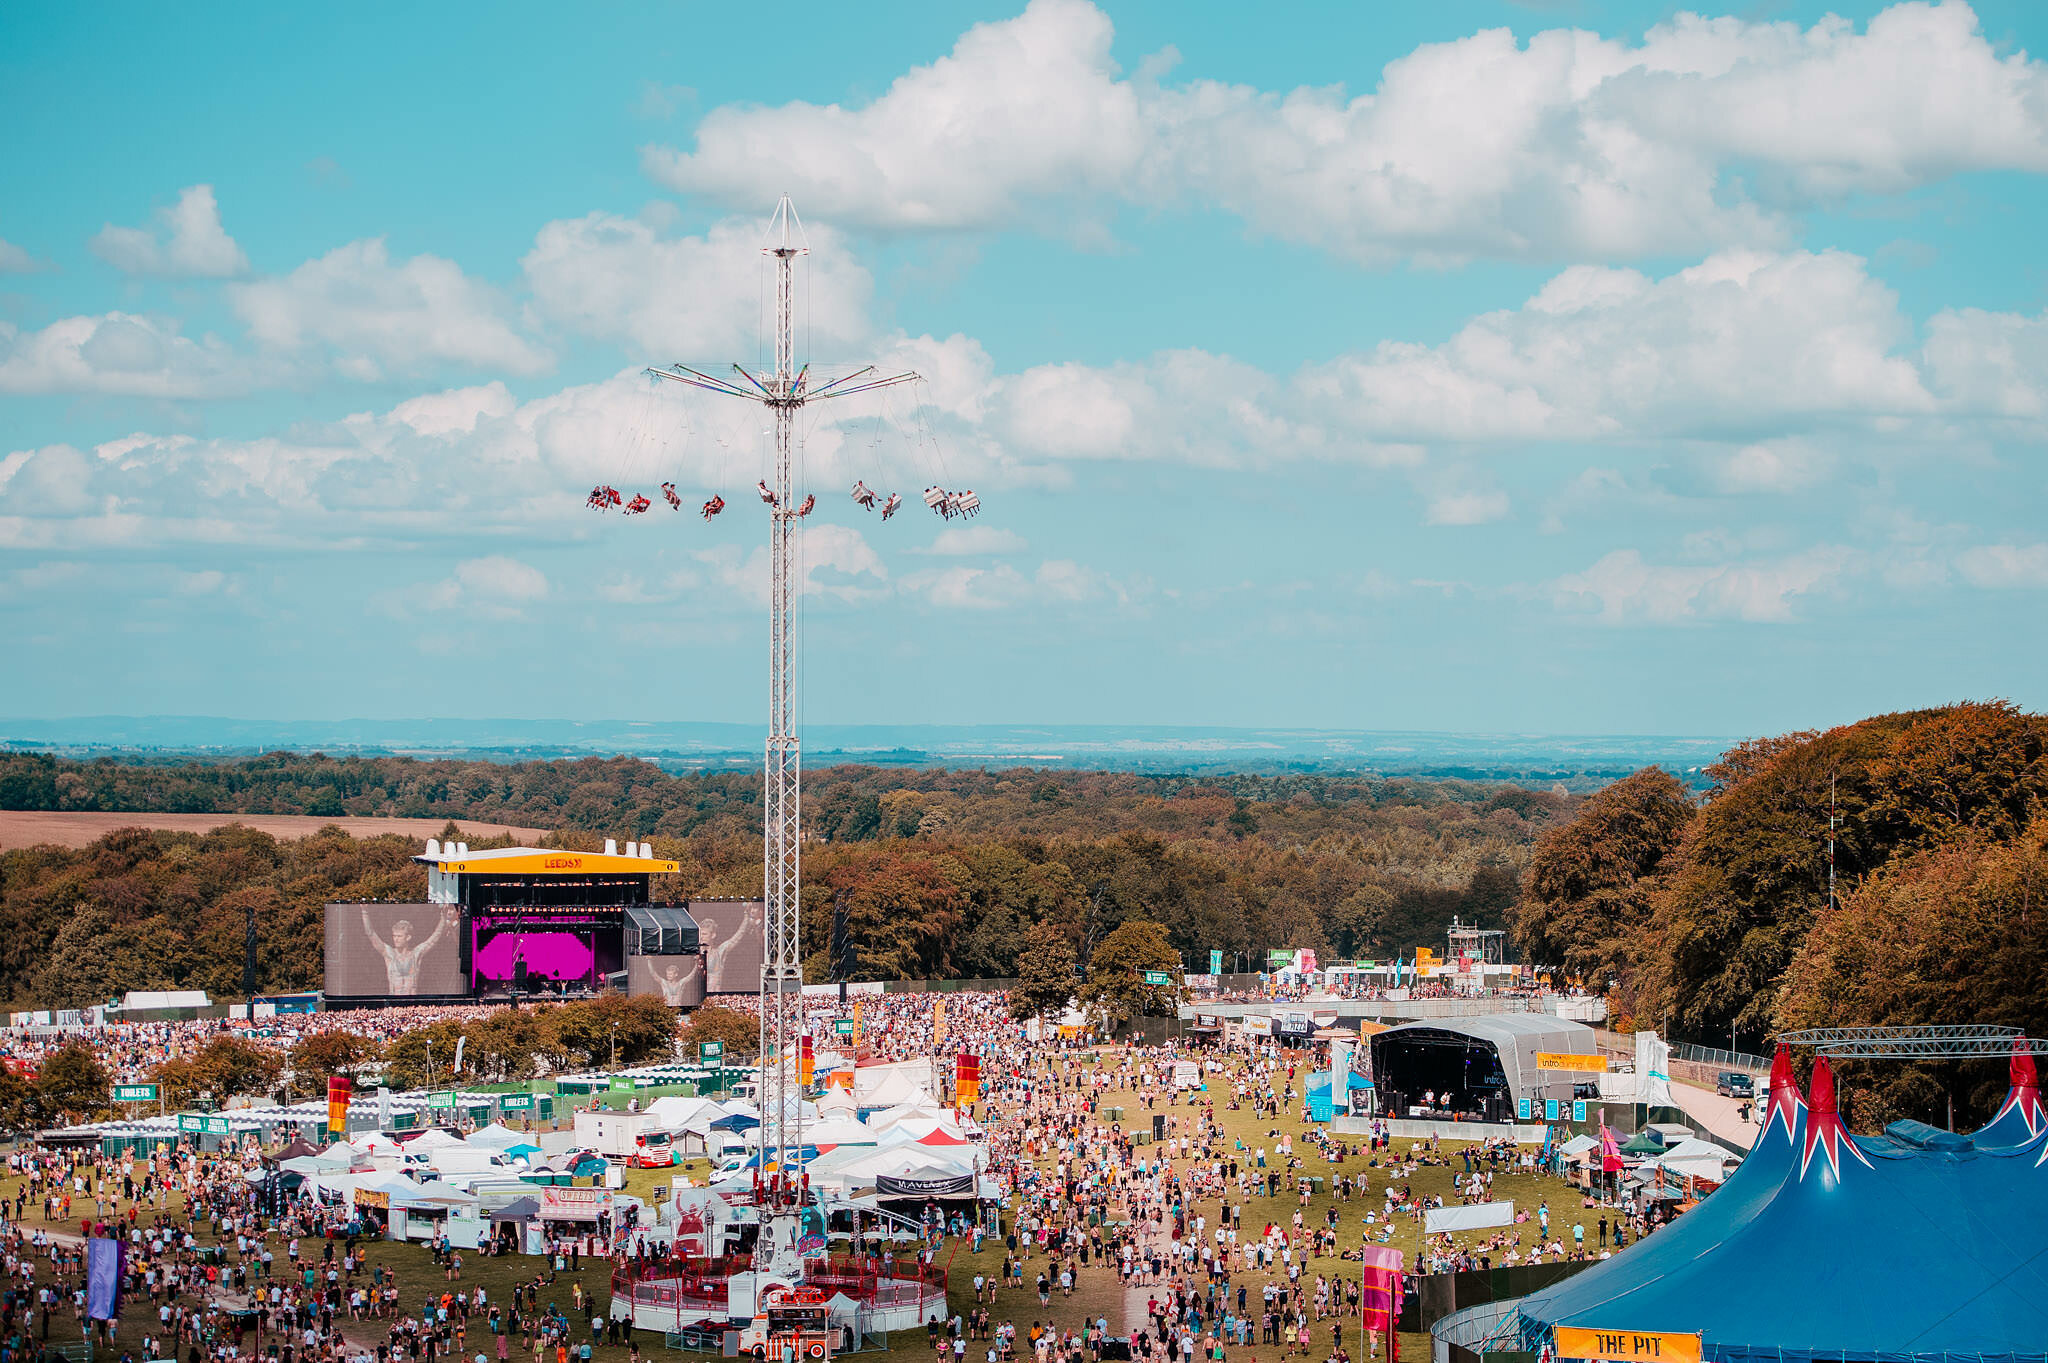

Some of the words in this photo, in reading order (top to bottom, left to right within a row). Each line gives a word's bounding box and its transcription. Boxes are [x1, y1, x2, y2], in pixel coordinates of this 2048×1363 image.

[545, 859, 573, 868] LEEDS
[120, 1087, 150, 1097] TOILETS
[505, 1098, 529, 1106] TOILETS
[561, 1187, 594, 1201] SWEETS
[1595, 1334, 1626, 1354] THE
[1634, 1336, 1661, 1356] PIT
